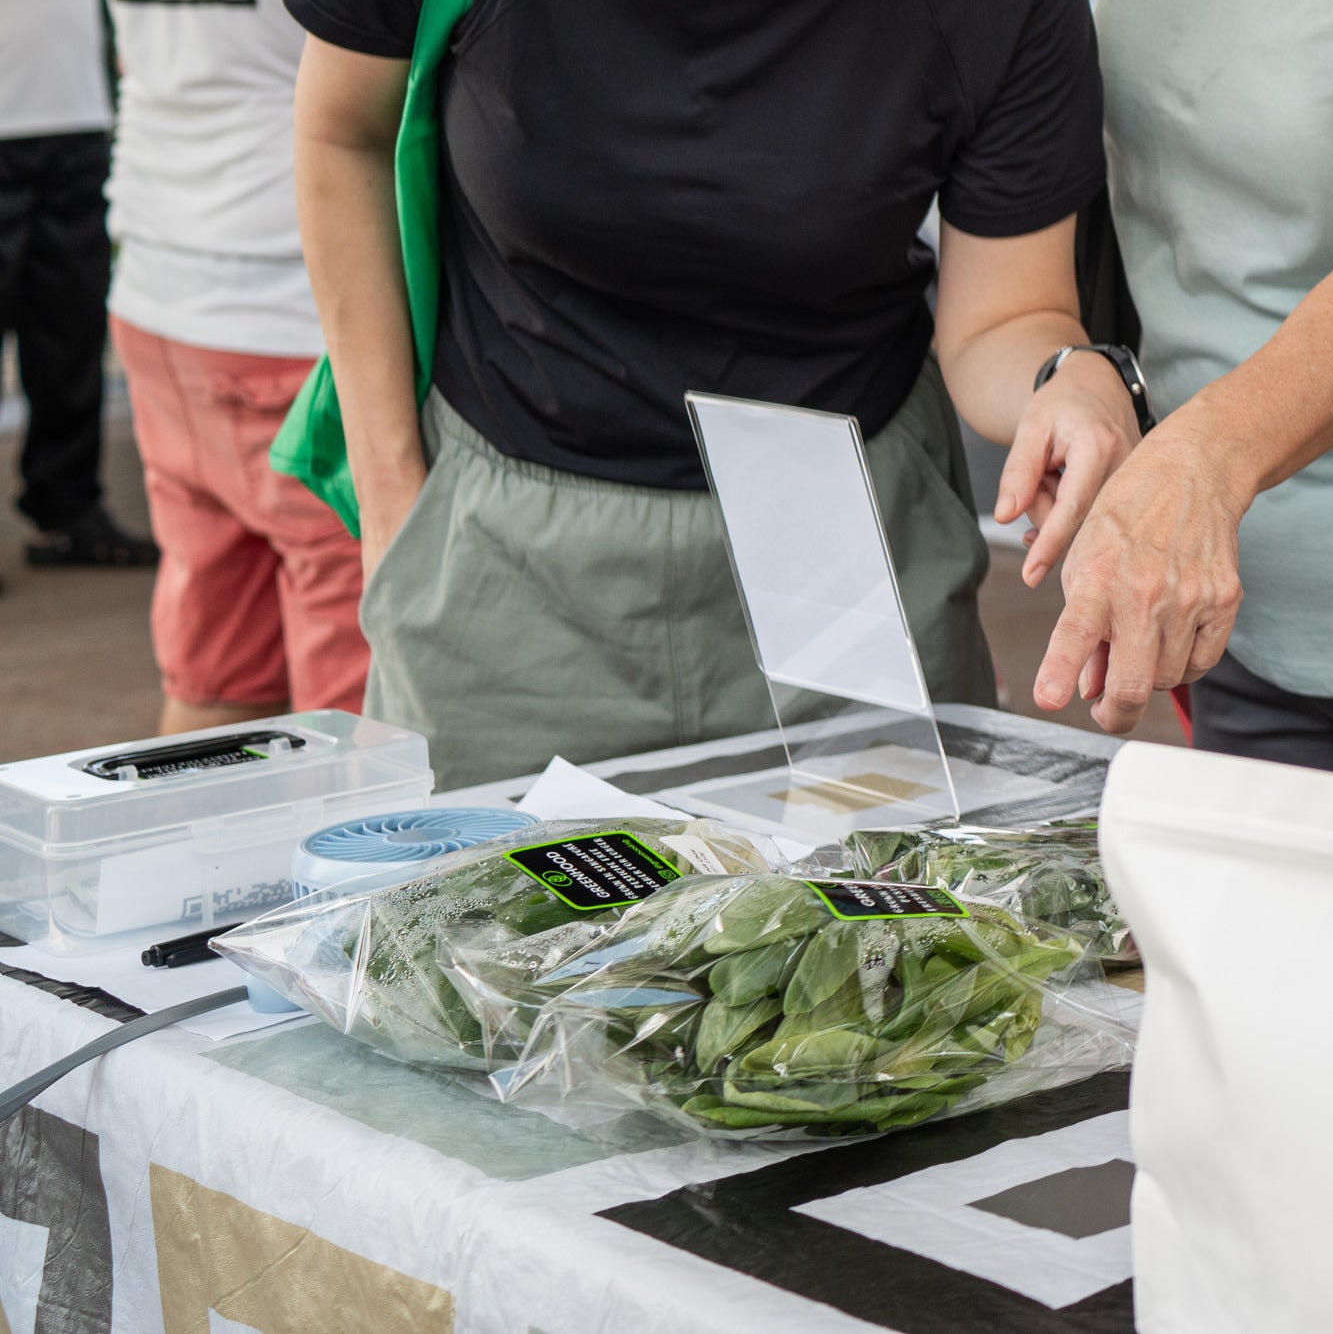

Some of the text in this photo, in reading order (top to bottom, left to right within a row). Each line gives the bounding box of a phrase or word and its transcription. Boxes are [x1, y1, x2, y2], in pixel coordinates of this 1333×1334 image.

[562, 843, 606, 873] SINGAPORE
[545, 851, 611, 898] GREENHOOD
[602, 872, 617, 881] IN
[612, 879, 639, 900] GROWN
